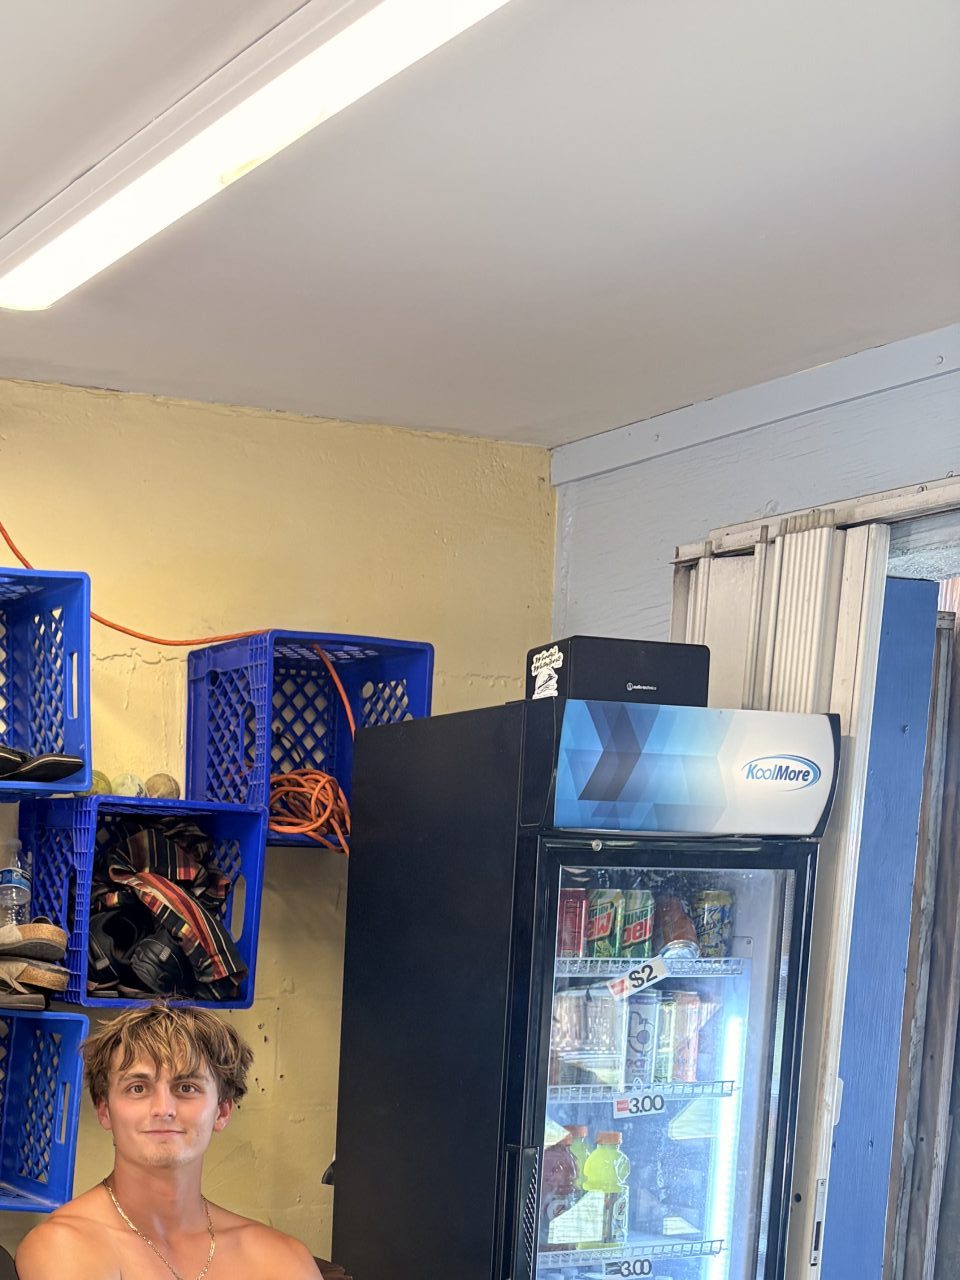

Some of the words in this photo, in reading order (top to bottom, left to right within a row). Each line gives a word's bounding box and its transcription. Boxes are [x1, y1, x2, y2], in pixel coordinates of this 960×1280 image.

[745, 763, 811, 782] KoolMore
[628, 964, 658, 989] $2
[628, 1094, 665, 1115] 3.00
[621, 1258, 653, 1278] 3.00
